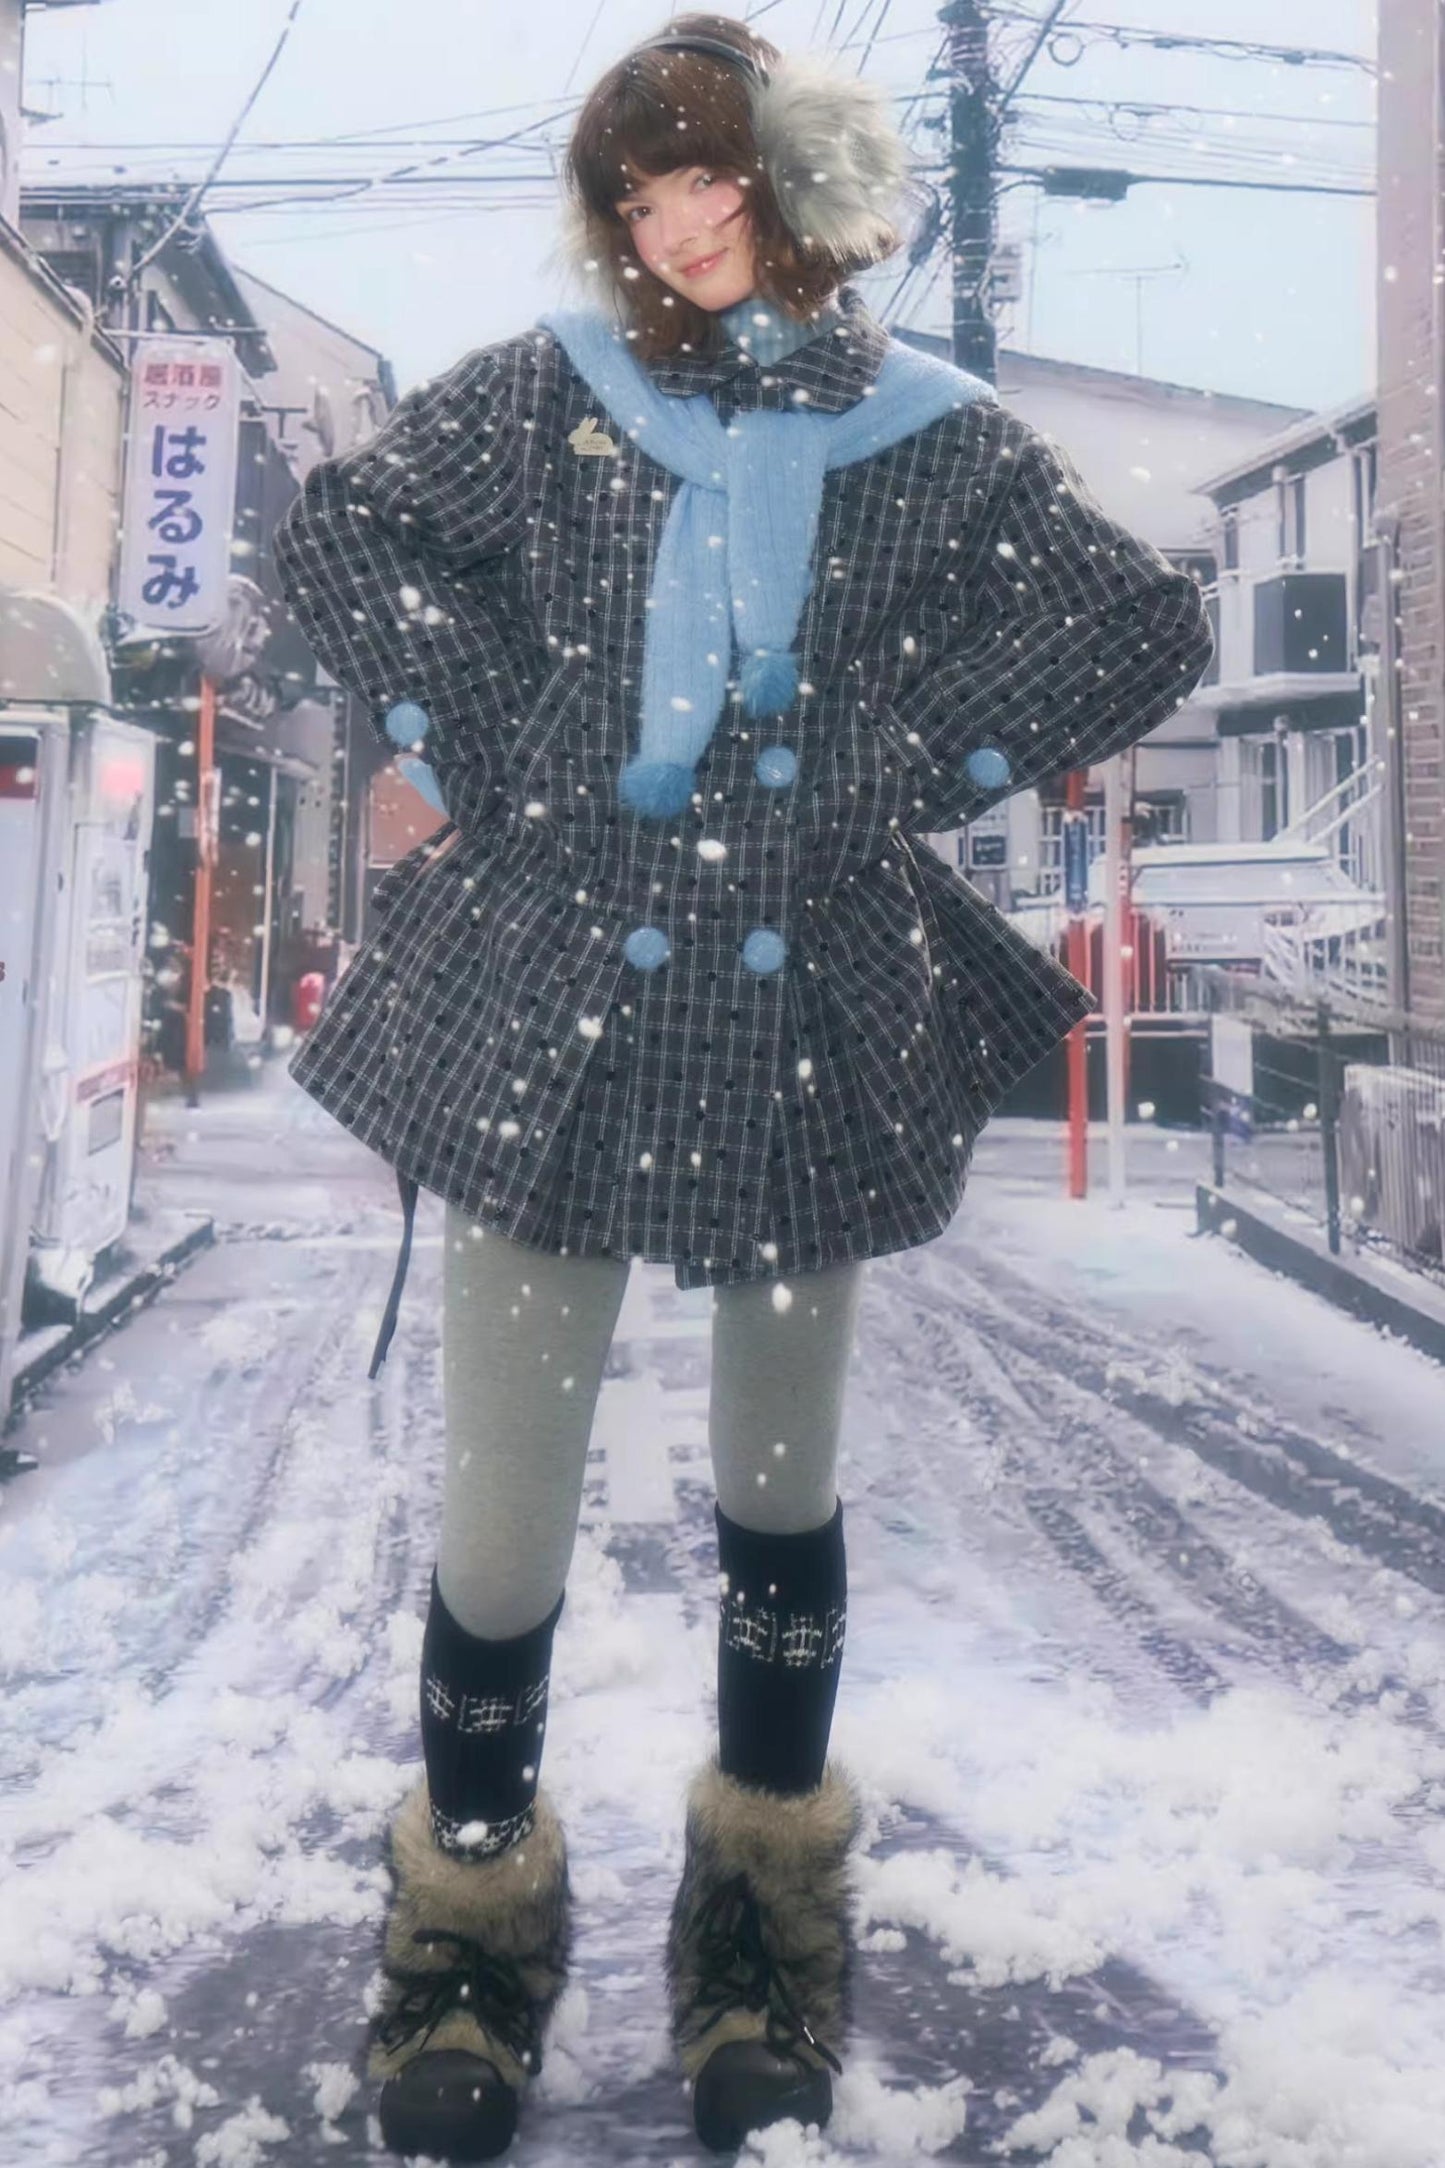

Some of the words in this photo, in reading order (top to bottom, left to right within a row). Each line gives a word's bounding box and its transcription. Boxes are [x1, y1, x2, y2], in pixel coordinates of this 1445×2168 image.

[143, 391, 221, 411] スナック
[142, 425, 207, 610] はるみ
